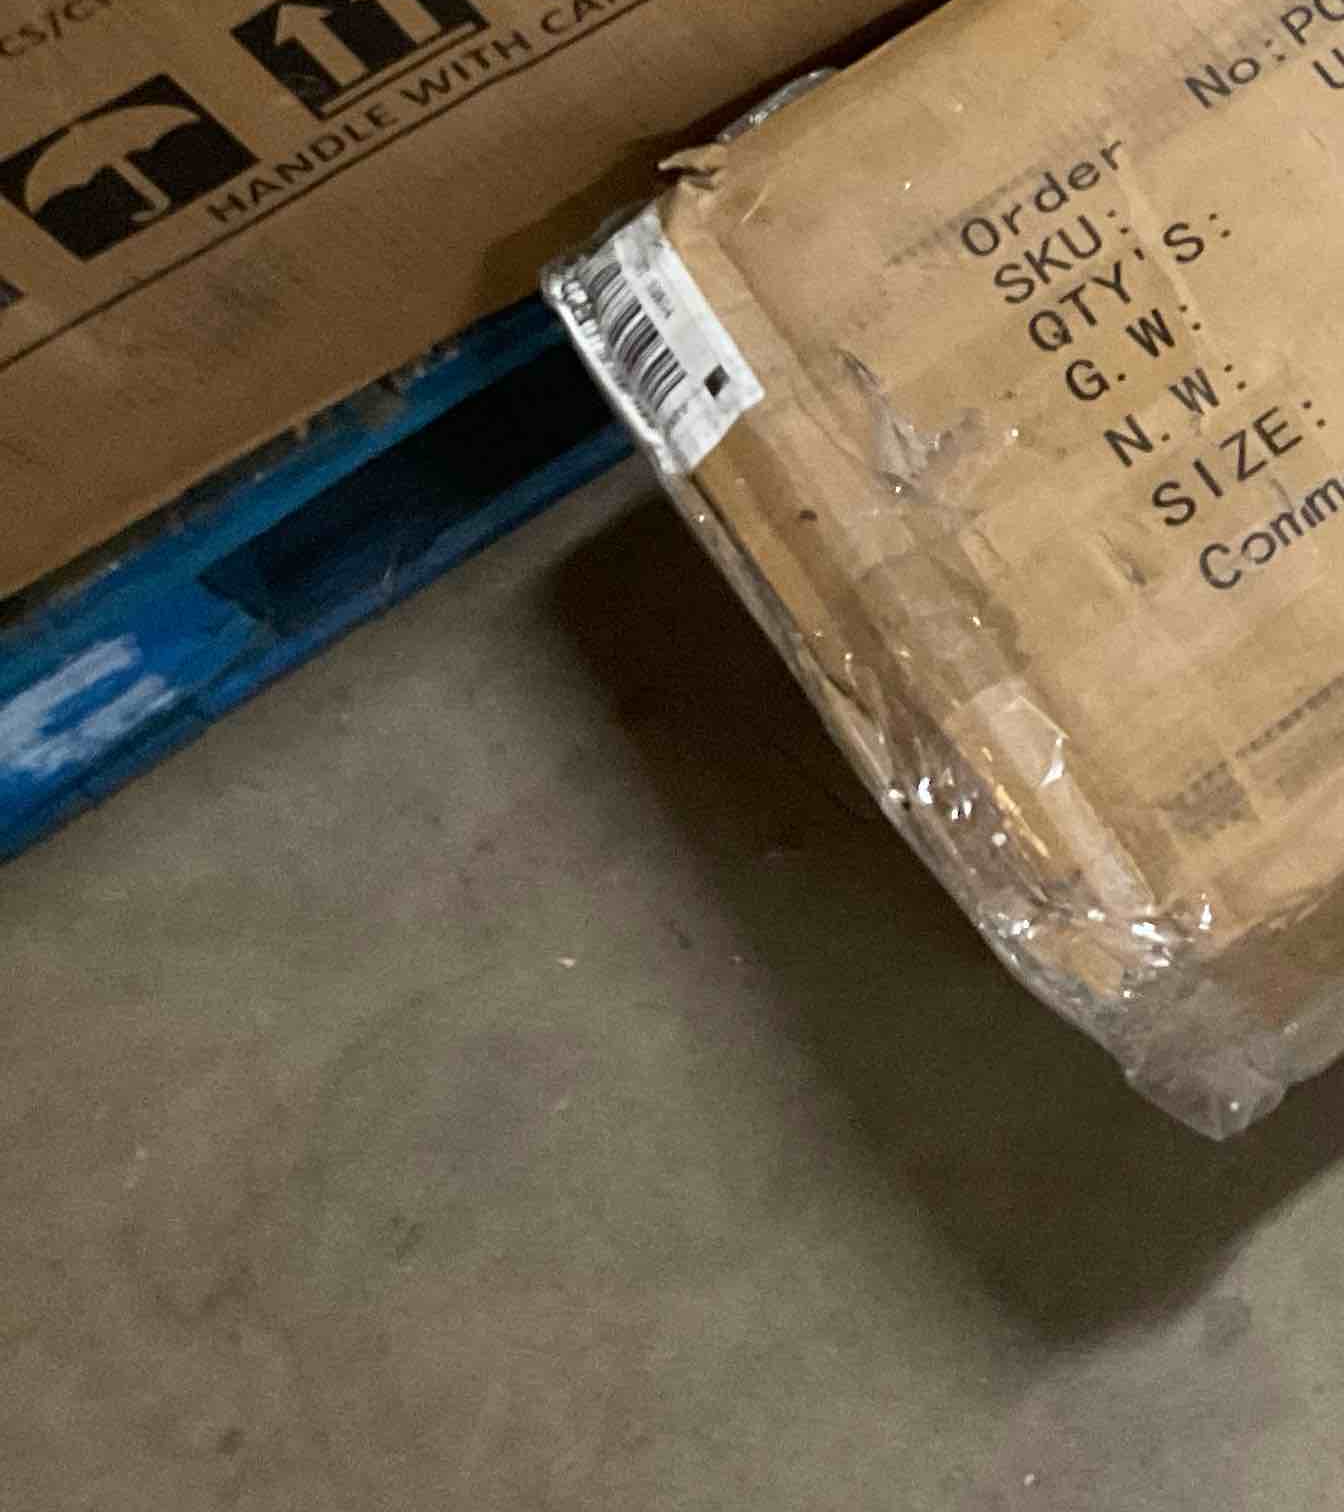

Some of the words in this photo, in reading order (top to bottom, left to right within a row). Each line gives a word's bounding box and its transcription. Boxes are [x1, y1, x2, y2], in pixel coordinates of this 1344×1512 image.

[206, 105, 399, 224] HANDLE
[400, 30, 532, 108] WITH
[960, 139, 1123, 257] Order
[994, 208, 1132, 304] SKU:
[1151, 399, 1328, 527] SIZE:
